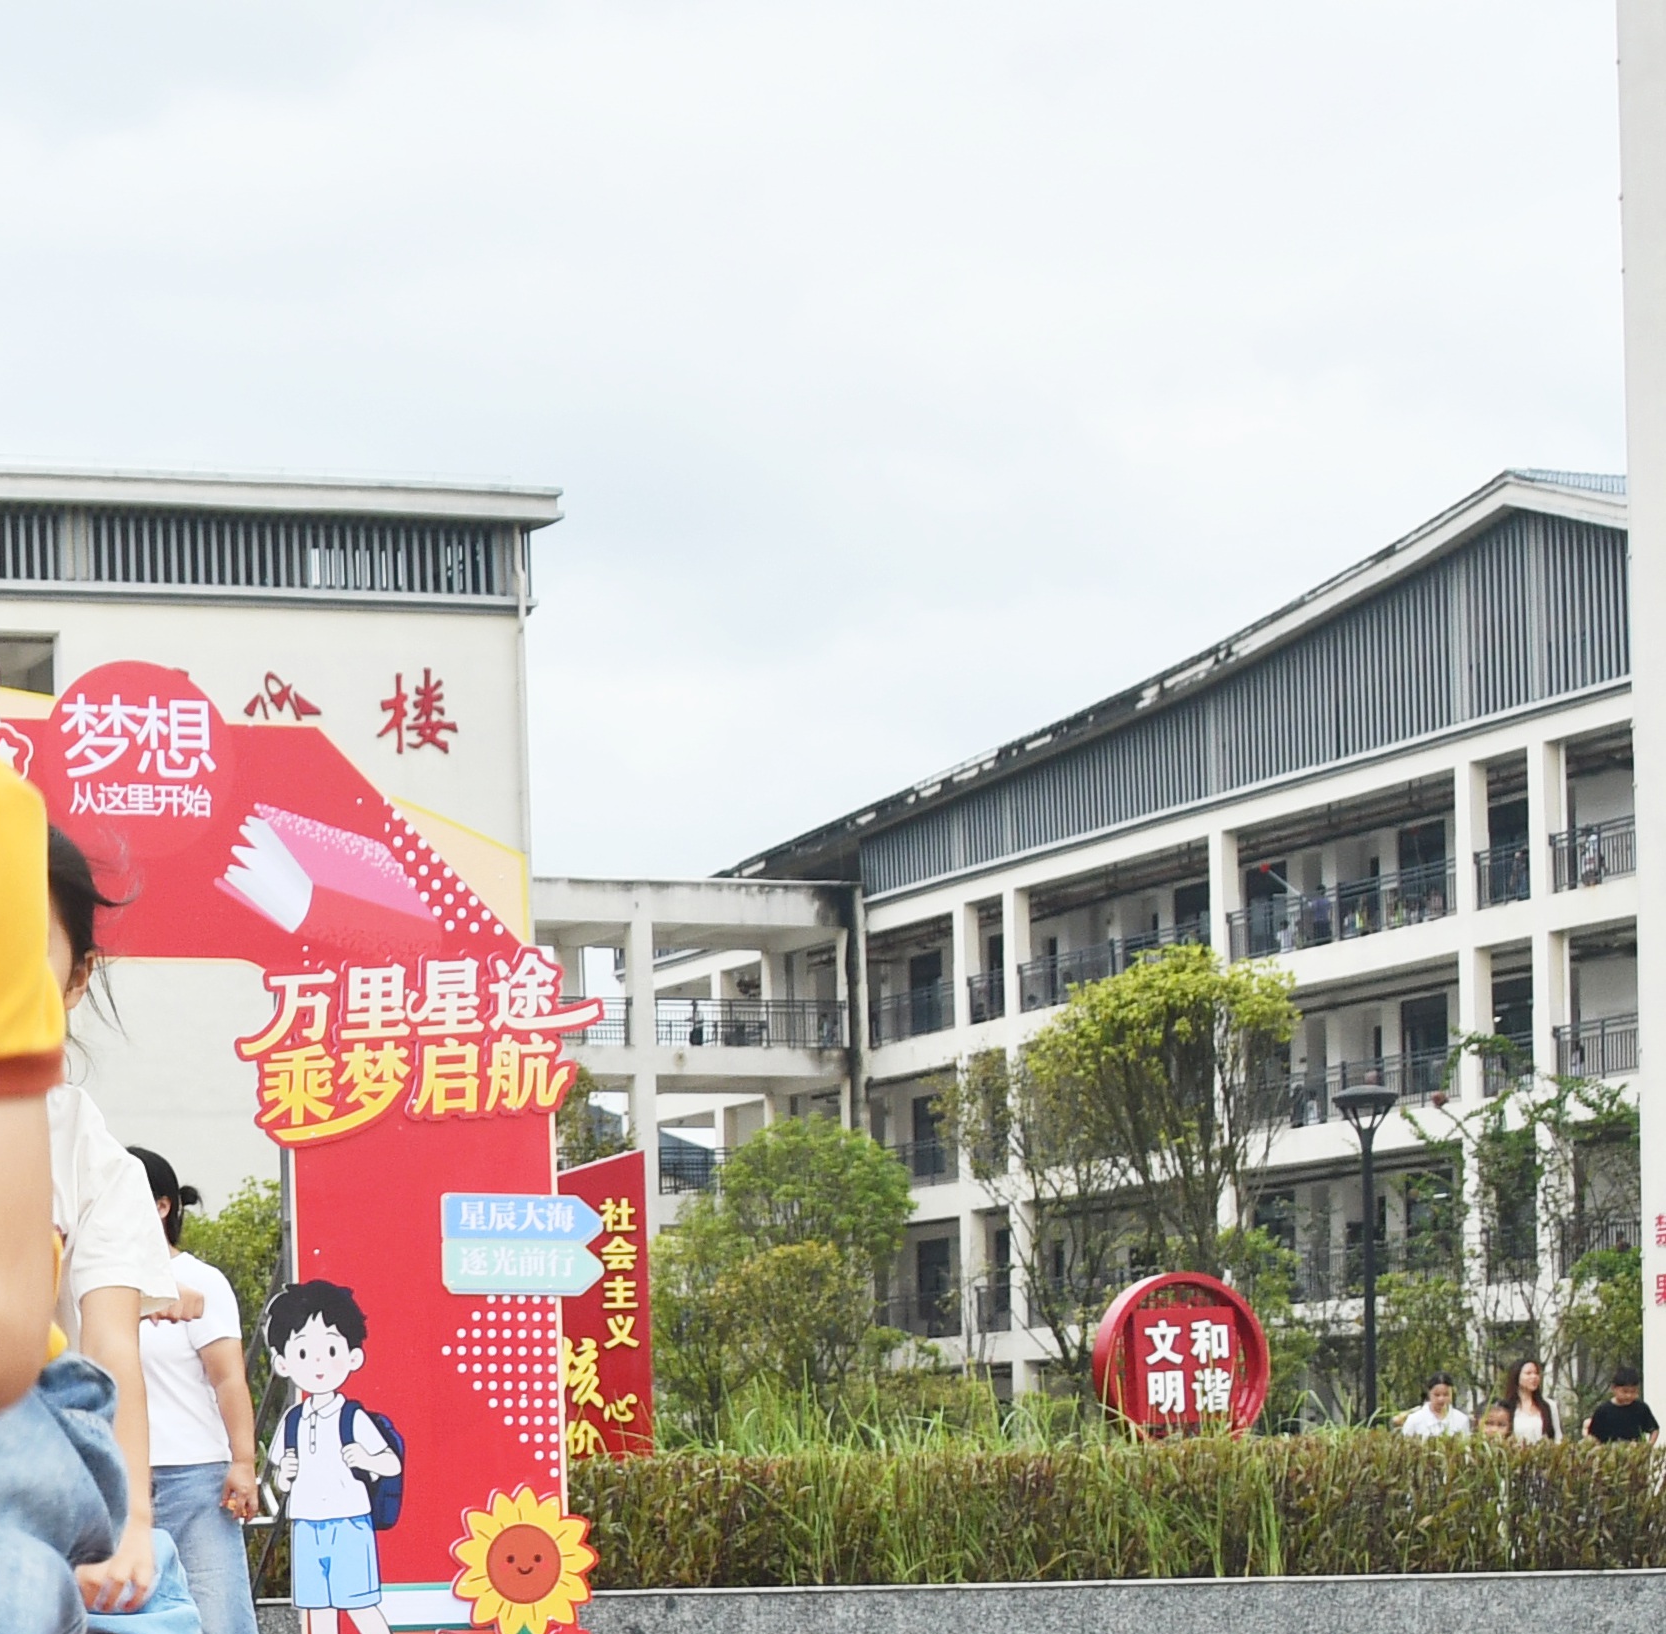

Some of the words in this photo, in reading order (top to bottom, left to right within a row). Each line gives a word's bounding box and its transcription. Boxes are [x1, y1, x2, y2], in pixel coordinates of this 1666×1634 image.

[61, 693, 216, 778] 梦想
[69, 781, 212, 818] 从这里开始
[241, 955, 602, 1057] 万里星途
[261, 1033, 569, 1142] 乘梦启航
[458, 1201, 576, 1233] 星辰大海
[458, 1246, 577, 1280] 逐光前行
[599, 1197, 641, 1350] 社会主义
